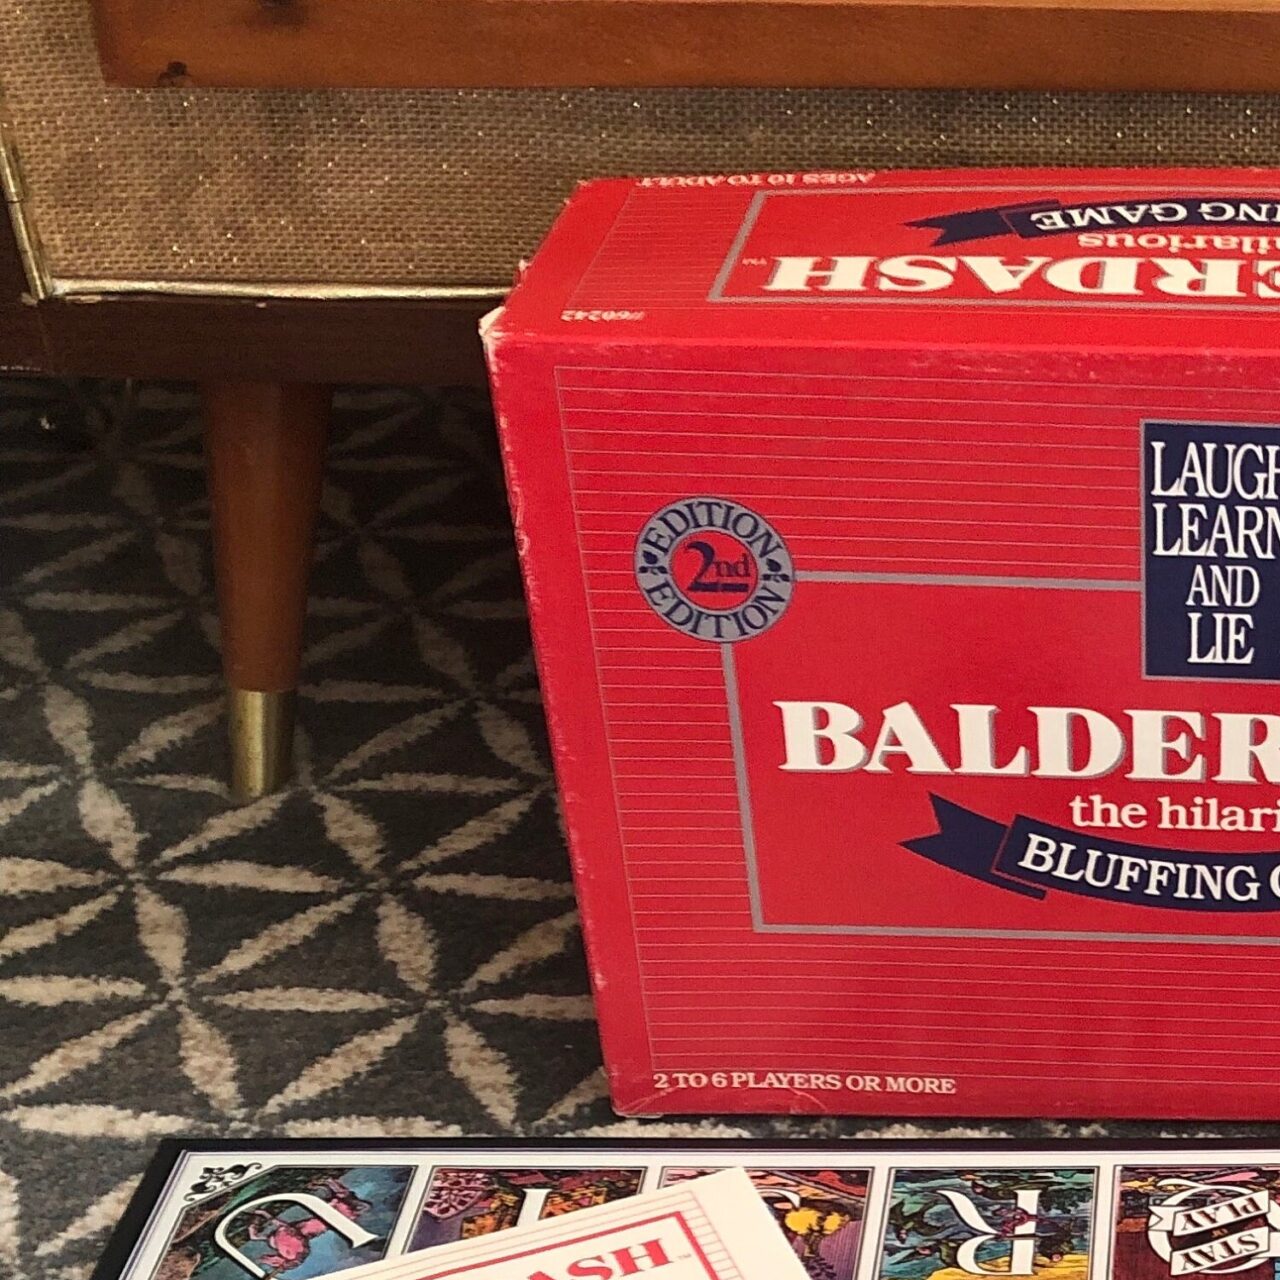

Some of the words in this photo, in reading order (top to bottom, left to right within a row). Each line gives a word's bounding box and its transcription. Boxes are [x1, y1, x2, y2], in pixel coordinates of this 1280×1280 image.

[727, 175, 762, 186] TO
[768, 174, 795, 186] 10
[802, 172, 876, 185] AGES
[1030, 201, 1191, 231] GAME
[645, 499, 782, 559] EDITION
[685, 540, 752, 592] 2nd
[1185, 564, 1261, 607] AND
[646, 580, 787, 639] EDITION
[1186, 612, 1255, 664] LIE
[1069, 795, 1147, 829] the
[1017, 832, 1260, 901] BLUFFING
[653, 1073, 669, 1089] 2
[672, 1073, 710, 1089] TO
[711, 1073, 729, 1089] 6
[731, 1072, 842, 1090] PLAYERS
[845, 1074, 882, 1092] OR
[885, 1076, 957, 1095] MORE
[1180, 1196, 1263, 1230] PLAY
[1179, 1232, 1261, 1271] STAY
